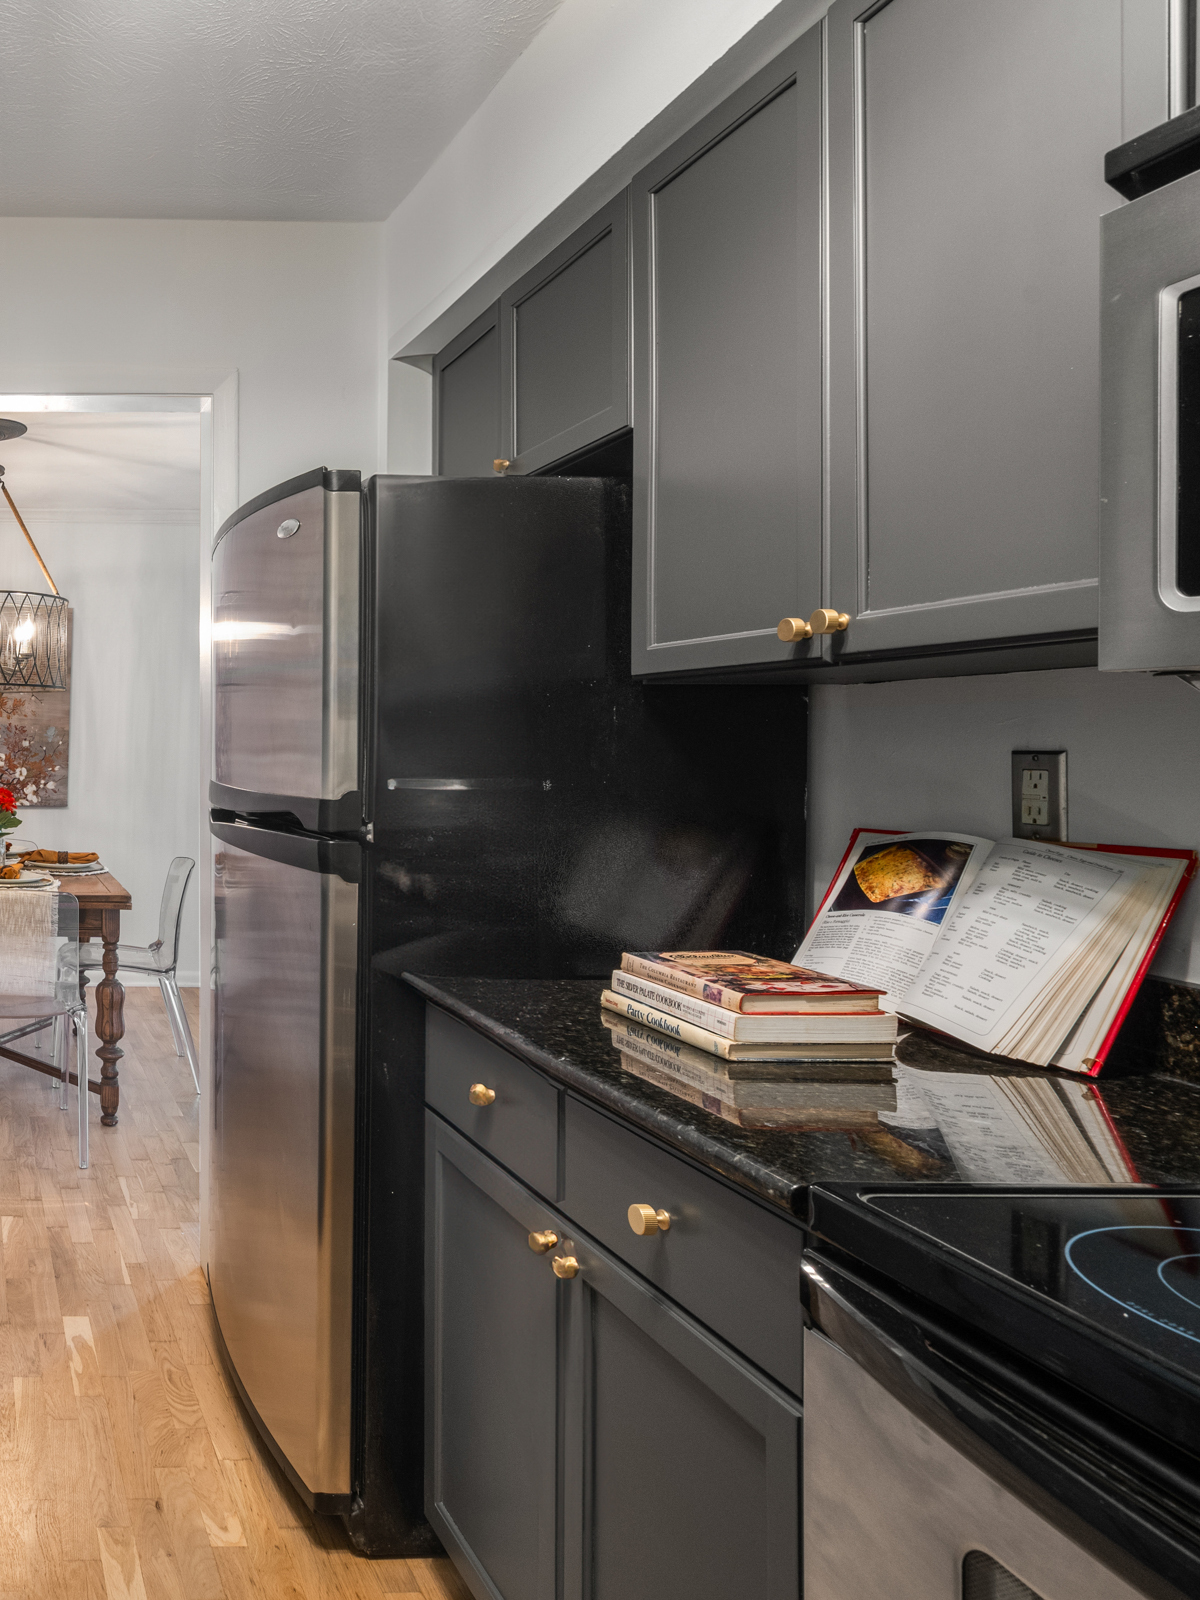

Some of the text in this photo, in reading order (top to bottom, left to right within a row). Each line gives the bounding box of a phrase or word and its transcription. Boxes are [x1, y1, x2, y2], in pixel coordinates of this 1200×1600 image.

[648, 965, 669, 978] COLUMBIA
[670, 974, 697, 988] RESTAURANT
[616, 978, 626, 989] THE
[626, 980, 639, 994] SILVER
[639, 984, 656, 1000] PALATE
[656, 991, 683, 1012] COOKBOOK
[627, 1003, 645, 1023] Party
[646, 1011, 682, 1037] Cookbook
